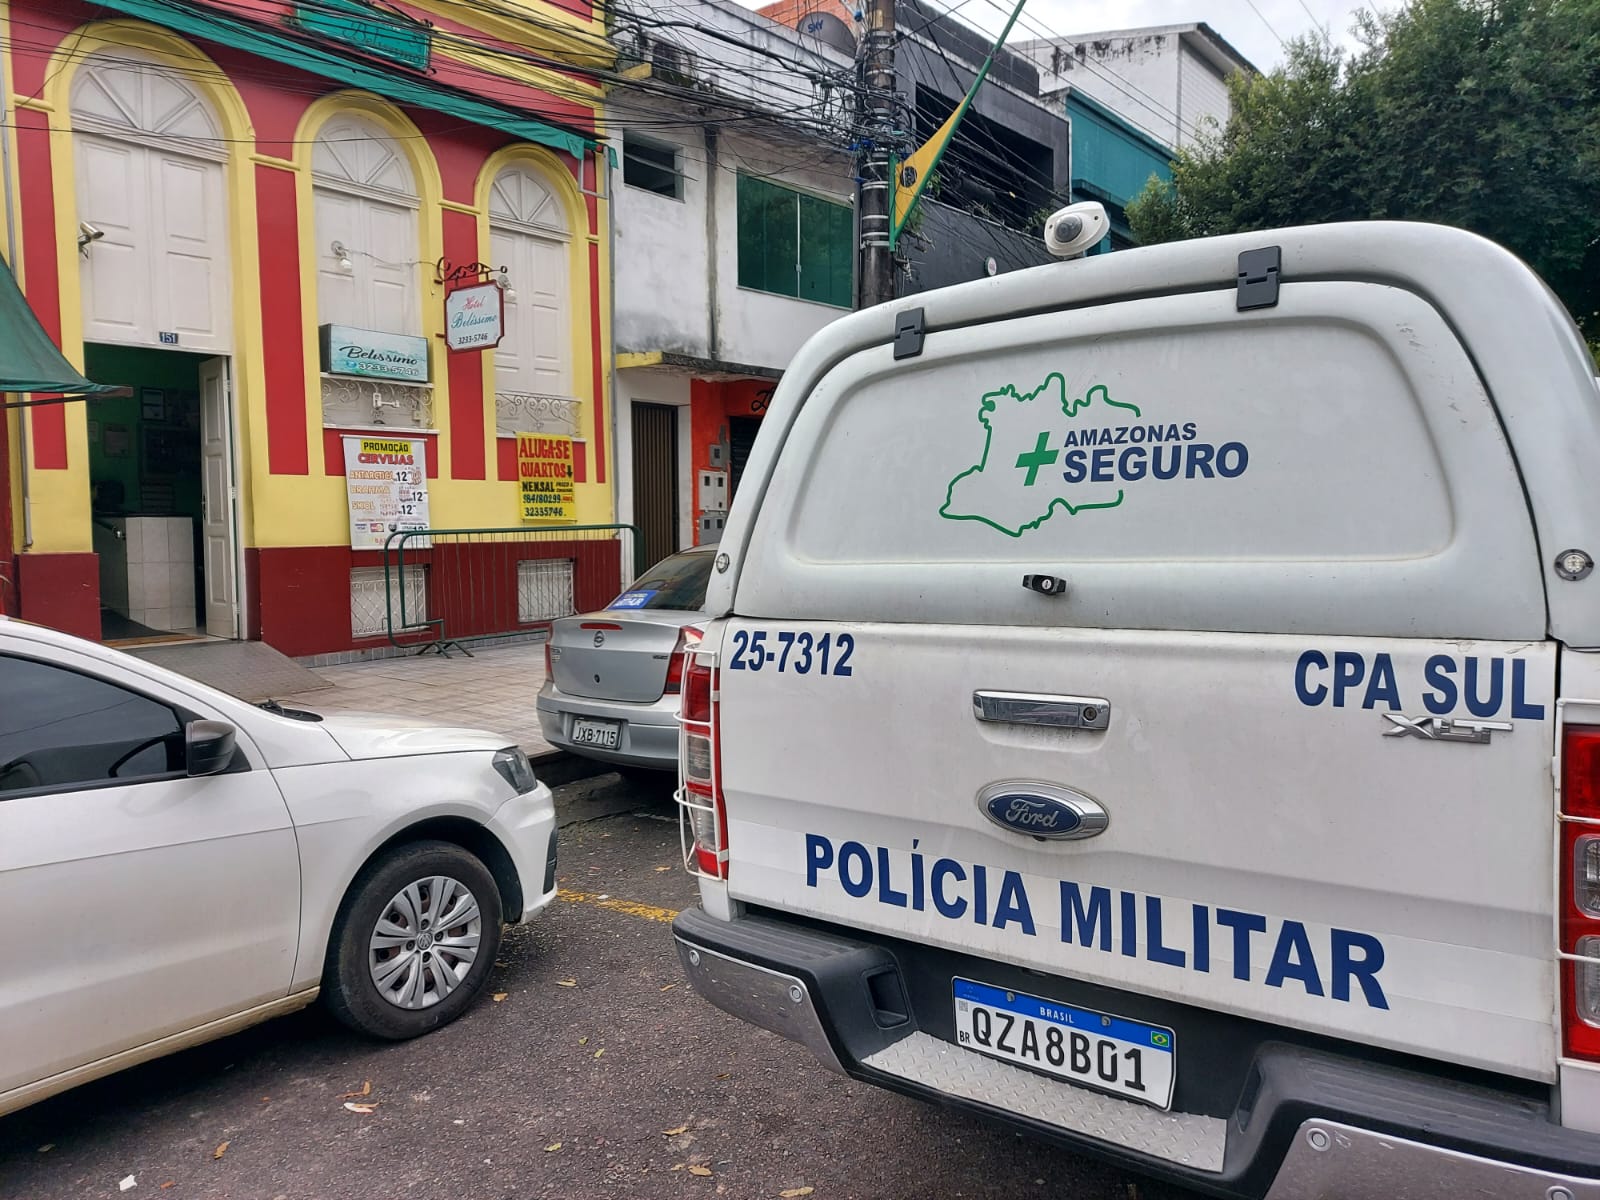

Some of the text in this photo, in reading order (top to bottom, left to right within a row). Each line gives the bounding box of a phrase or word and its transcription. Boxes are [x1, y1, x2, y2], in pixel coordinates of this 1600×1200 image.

[458, 333, 488, 344] 3233-5746
[339, 345, 418, 365] Belissimo
[363, 441, 409, 454] PROMOÇÃO
[519, 437, 570, 459] ALUGA-SE
[1063, 422, 1197, 448] AMAZONAS
[520, 462, 566, 478] QUARTOS
[1062, 441, 1249, 484] SEGURO
[729, 629, 855, 677] 25-7312
[1294, 649, 1545, 721] CPA SUL
[1382, 712, 1513, 745] XLT
[1005, 798, 1060, 828] Ford
[805, 833, 1390, 1011] POLÍCIA MILITAR
[1040, 1006, 1075, 1024] BRASIL
[959, 1030, 971, 1044] BR
[972, 1007, 1146, 1092] QZA8B01
